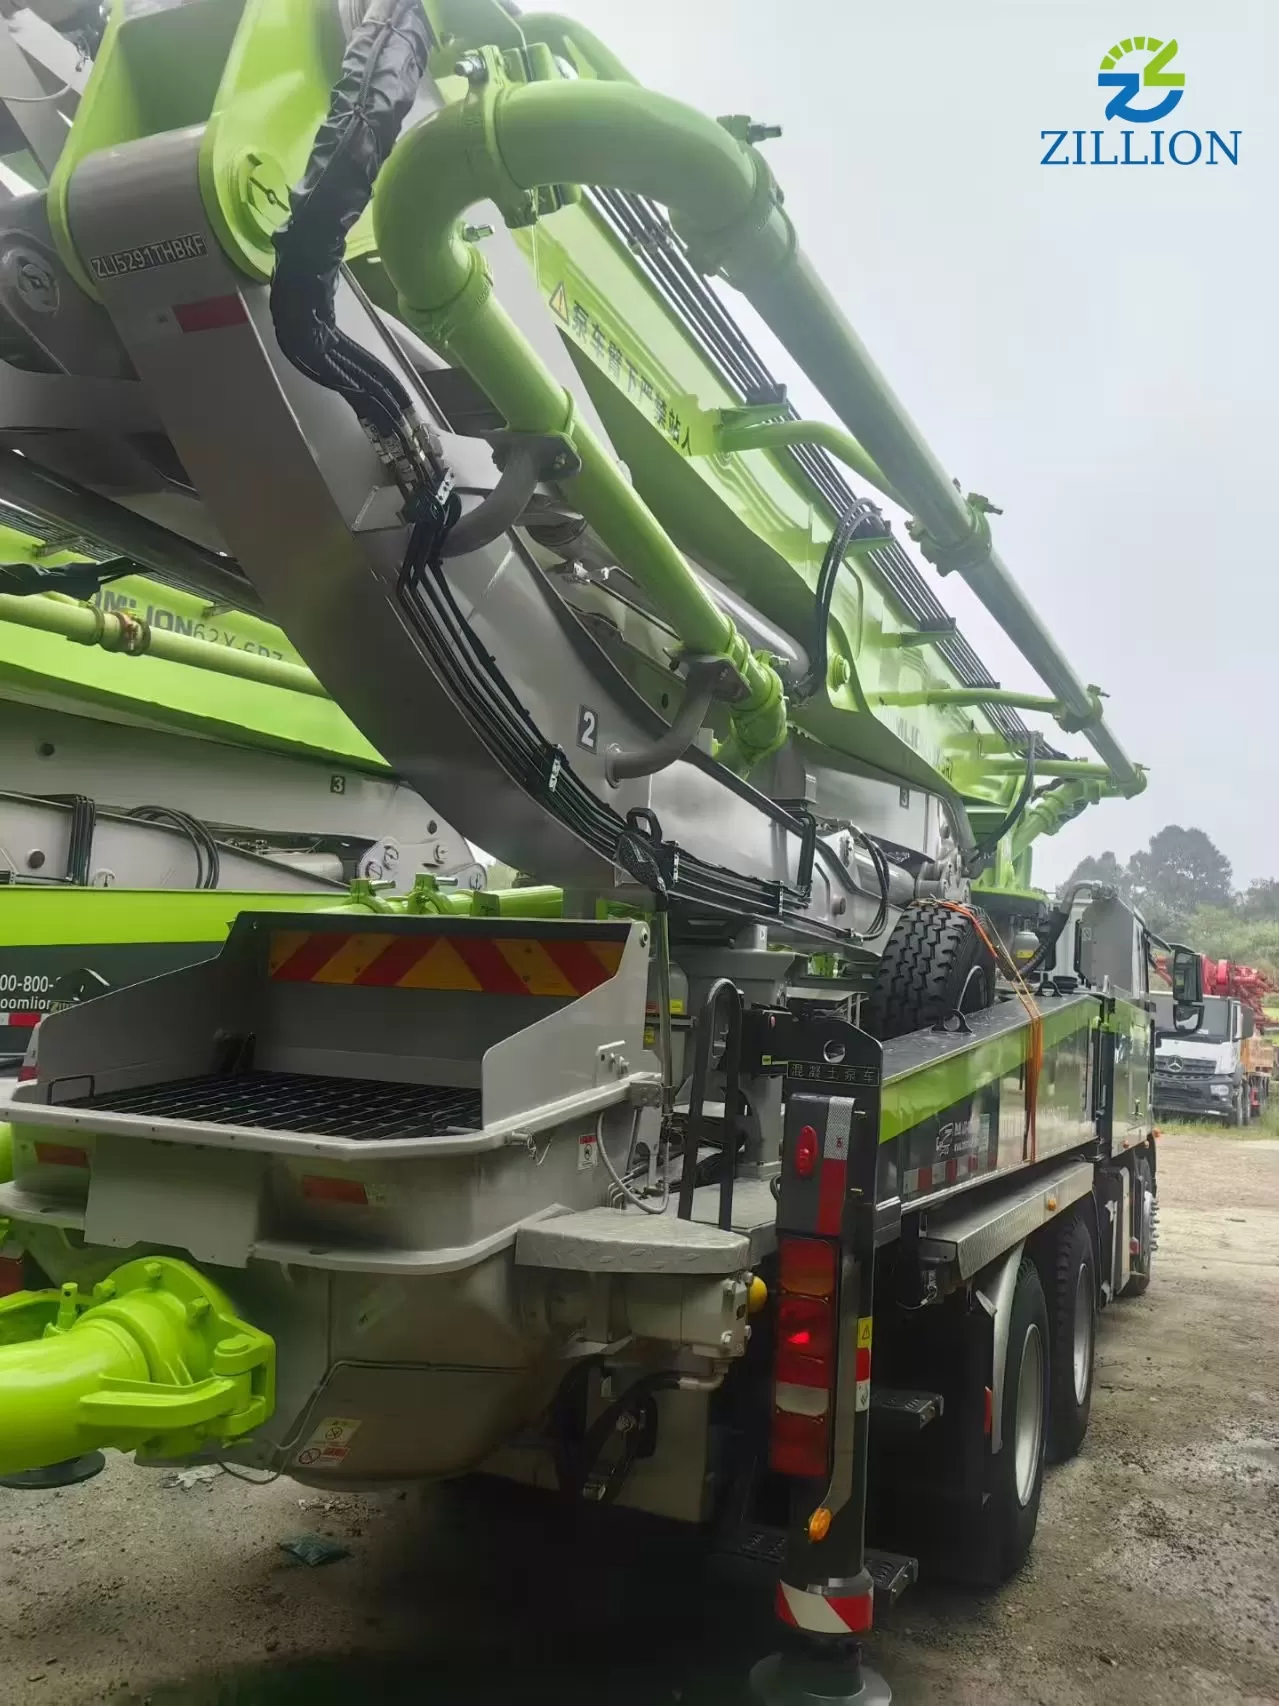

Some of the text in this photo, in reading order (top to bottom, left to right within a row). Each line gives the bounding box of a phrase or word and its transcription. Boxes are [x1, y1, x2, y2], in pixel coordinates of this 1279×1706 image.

[91, 235, 205, 278] ZLJ5291THBKF
[580, 711, 595, 748] 2
[333, 776, 343, 793] 3
[791, 1063, 875, 1081] 混凝土泵车
